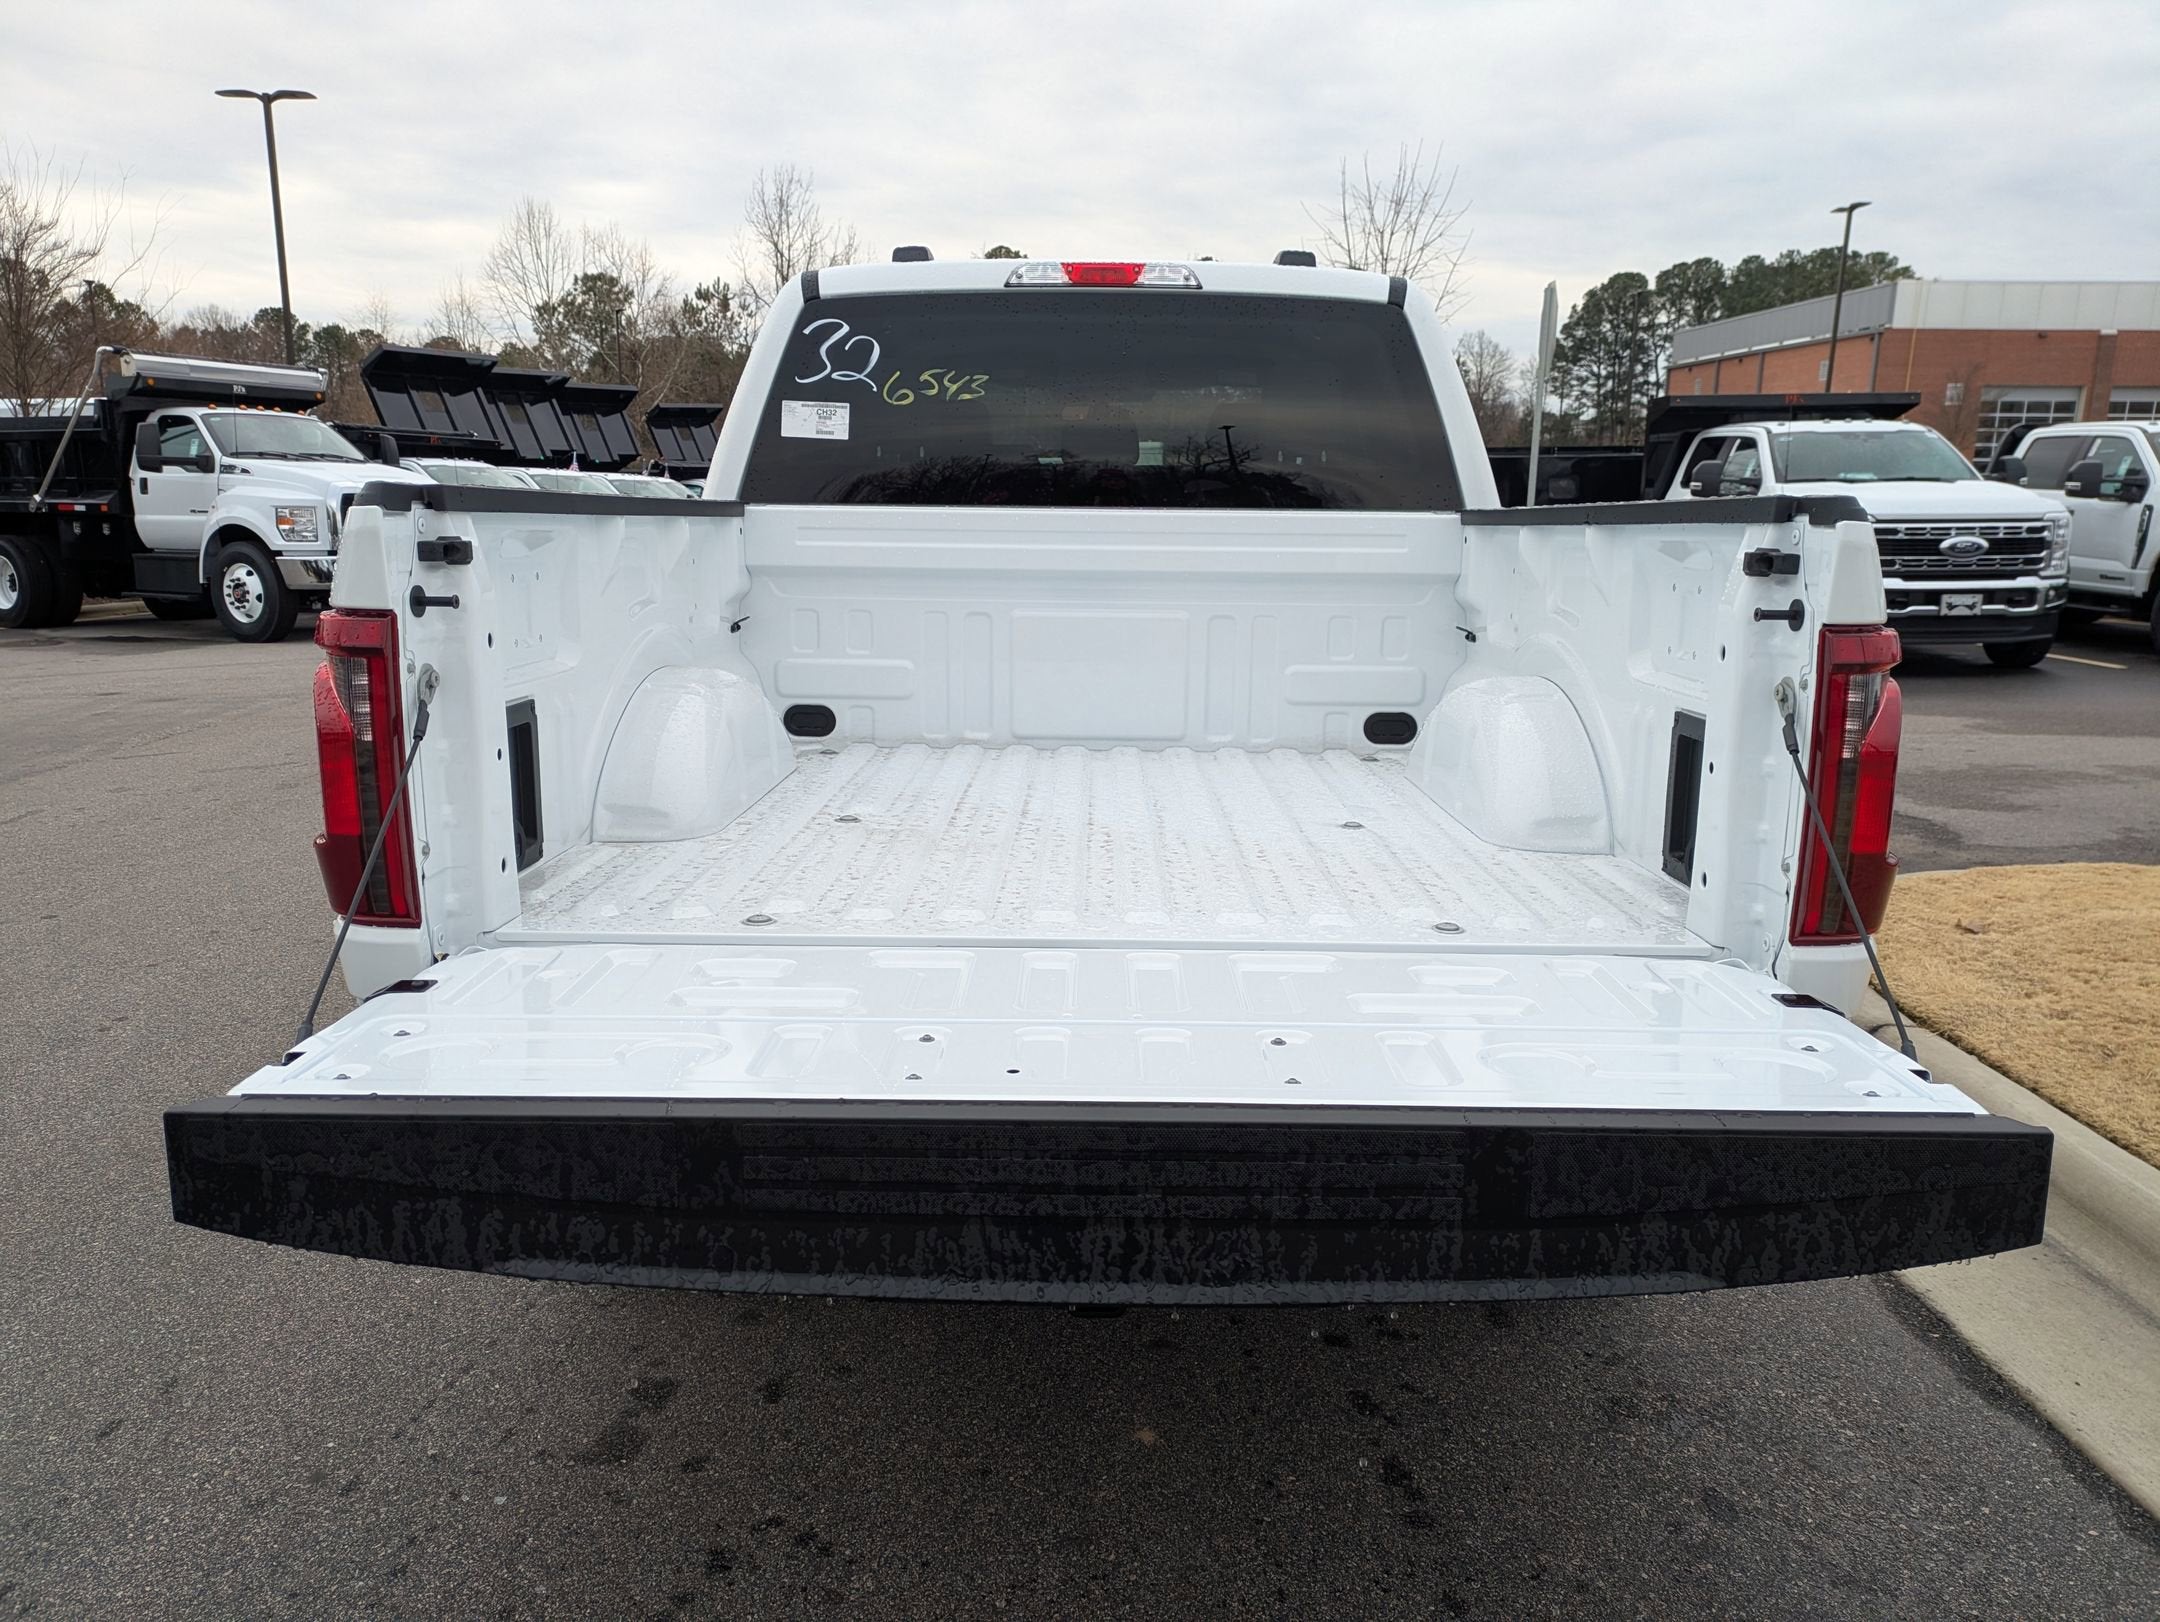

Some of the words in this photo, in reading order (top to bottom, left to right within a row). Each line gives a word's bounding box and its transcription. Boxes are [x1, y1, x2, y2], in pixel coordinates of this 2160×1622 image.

[795, 318, 881, 393] 32
[882, 368, 990, 406] 6543
[816, 408, 838, 417] CH32
